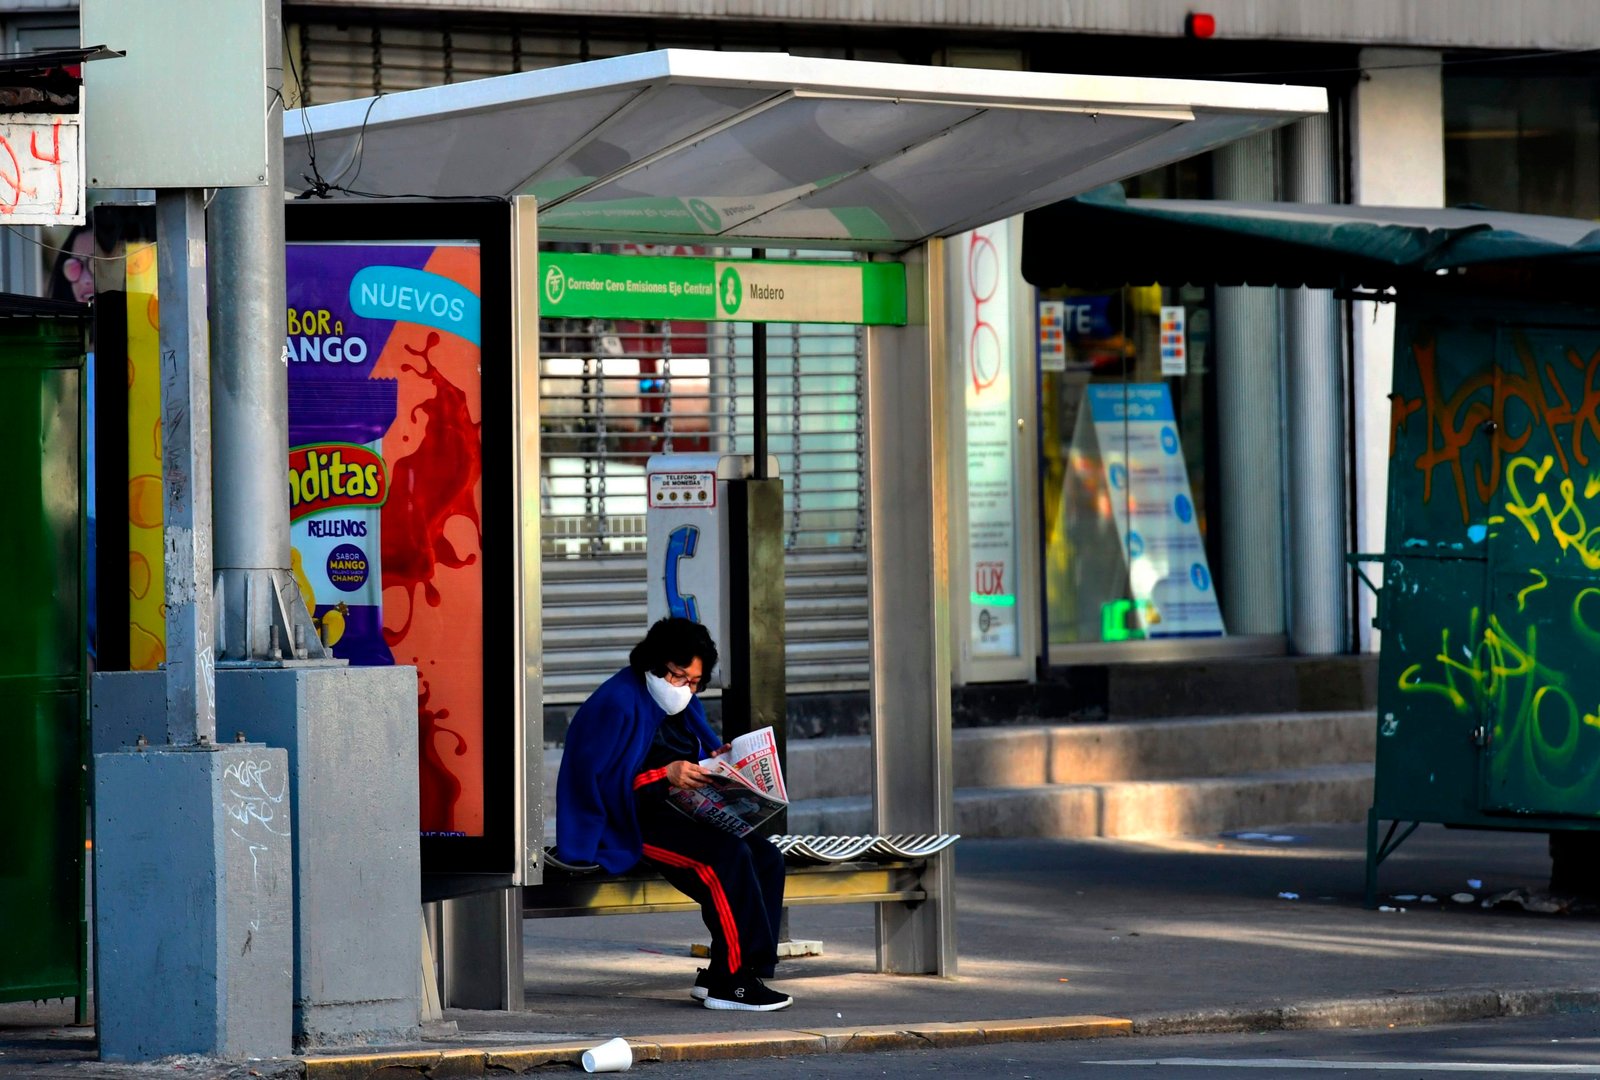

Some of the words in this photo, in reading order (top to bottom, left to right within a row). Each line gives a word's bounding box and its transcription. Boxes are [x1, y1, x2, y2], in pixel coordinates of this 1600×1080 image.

[567, 277, 604, 290] Corredor
[605, 279, 625, 292] Cero
[626, 279, 667, 293] Emisiones
[669, 281, 682, 296] Eje
[683, 282, 713, 295] Central
[750, 283, 785, 300] Madero
[361, 283, 465, 322] NUEVOS
[287, 308, 331, 336] BOR
[308, 519, 367, 537] RELLENOS
[330, 560, 366, 569] MANGO
[335, 552, 360, 560] SABOR
[976, 568, 1004, 595] LUX
[760, 758, 773, 788] CAZAN
